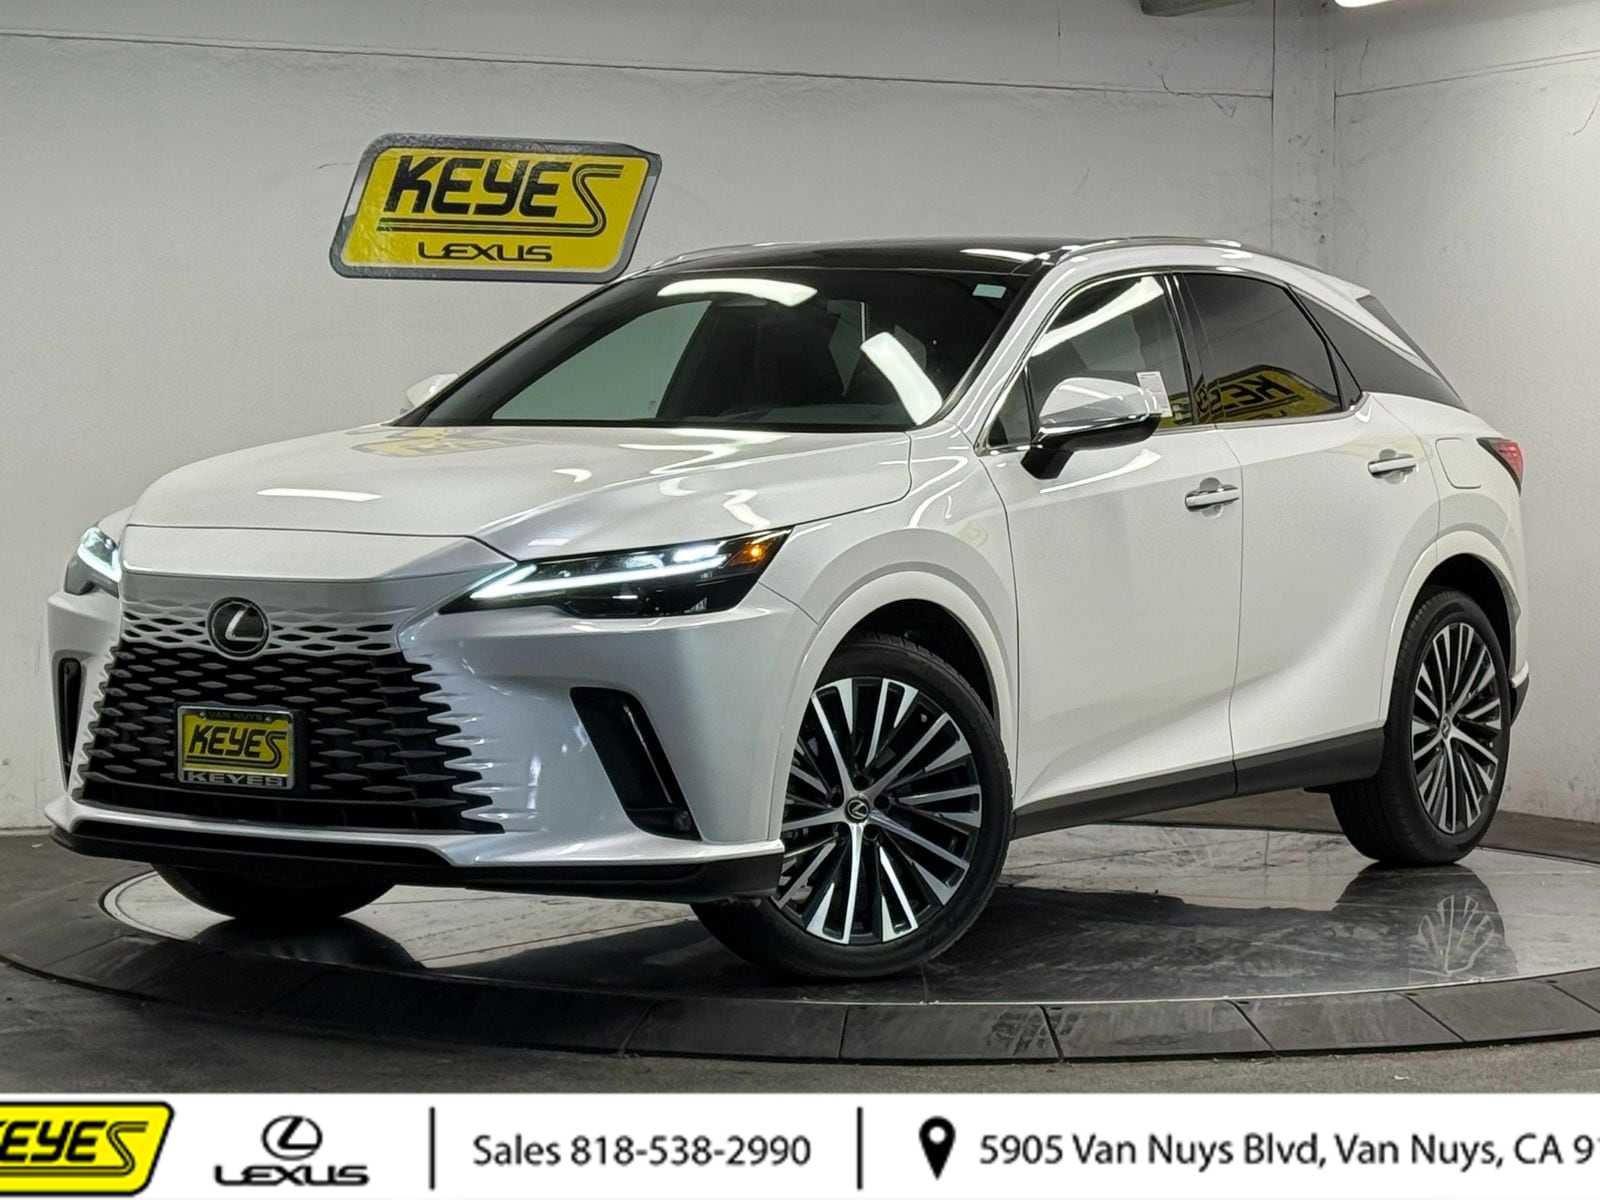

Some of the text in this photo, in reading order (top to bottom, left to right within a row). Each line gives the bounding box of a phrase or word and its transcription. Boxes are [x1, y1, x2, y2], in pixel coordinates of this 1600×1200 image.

[377, 155, 624, 237] KEYES
[418, 241, 553, 262] LEXUS
[187, 724, 287, 769] KEYES
[187, 772, 284, 787] KEYES
